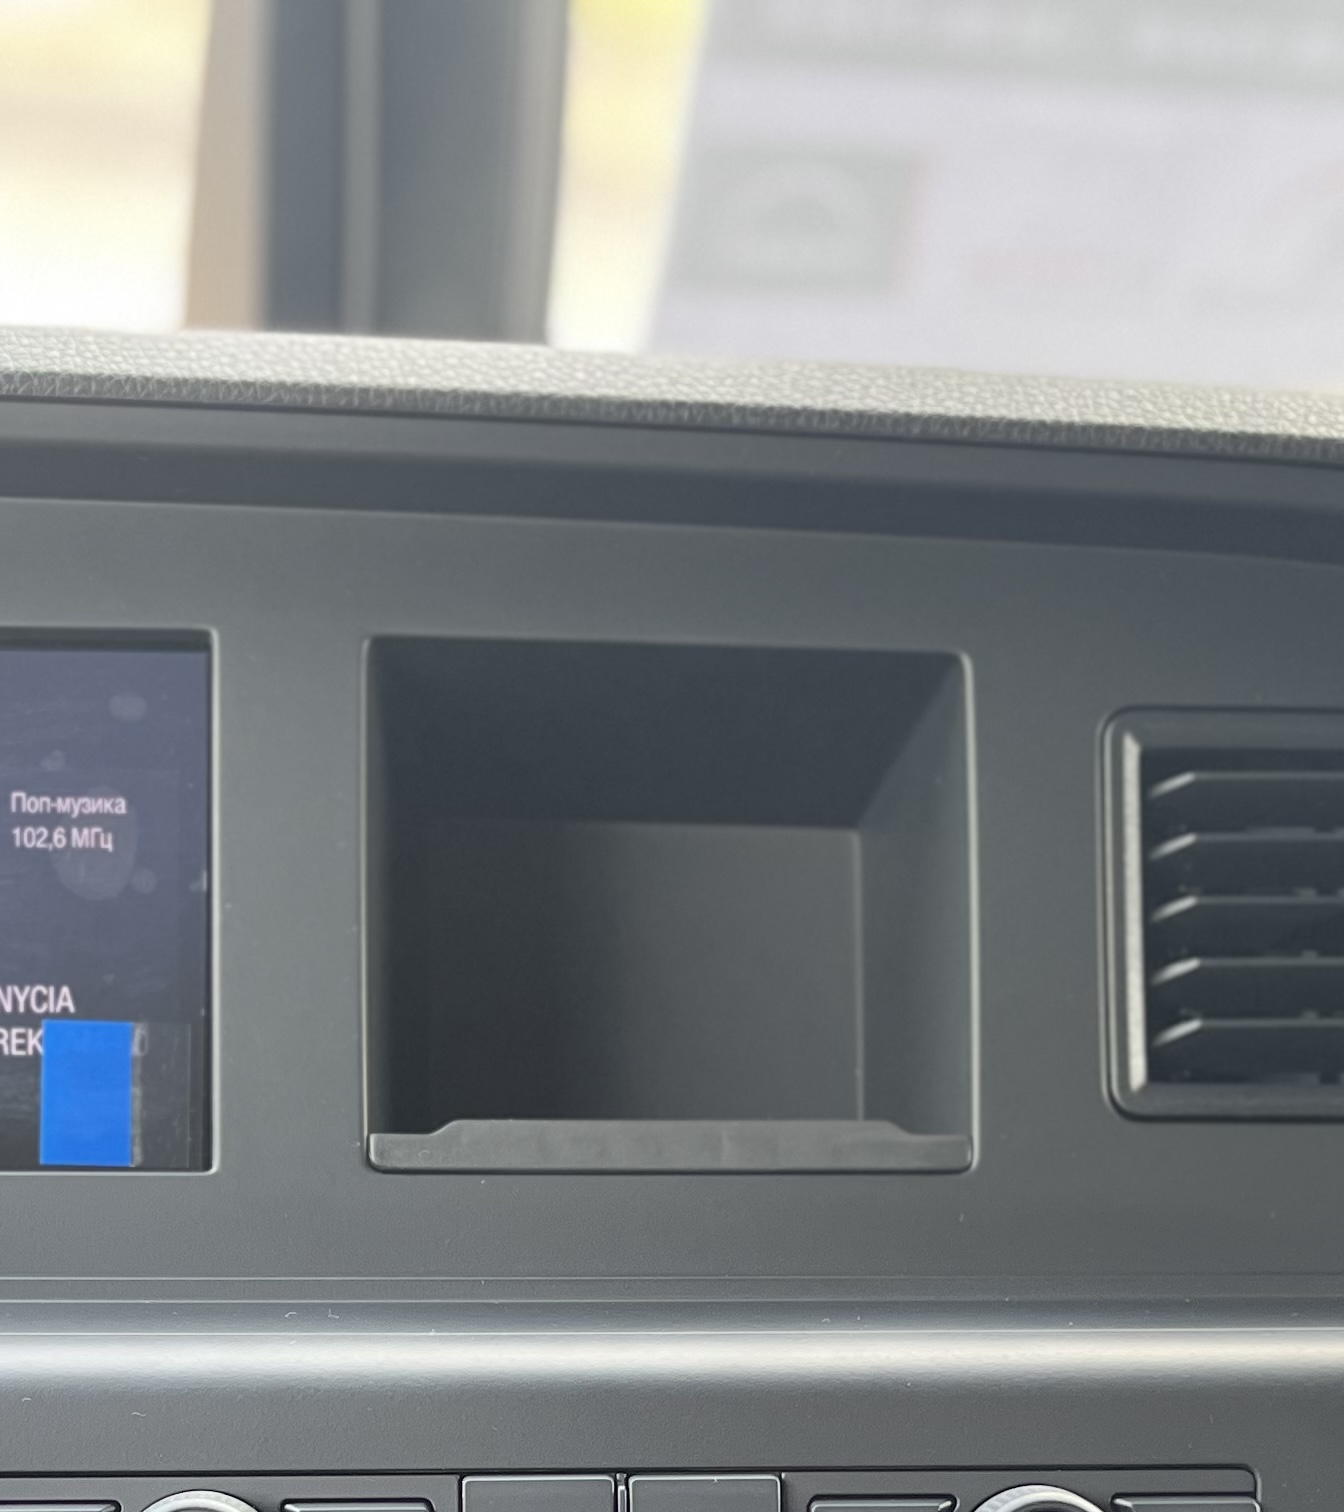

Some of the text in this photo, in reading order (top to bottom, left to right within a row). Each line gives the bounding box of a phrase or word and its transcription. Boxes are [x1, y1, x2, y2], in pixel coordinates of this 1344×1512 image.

[10, 791, 127, 818] Поп-музика
[12, 826, 114, 853] 102,6 МГц
